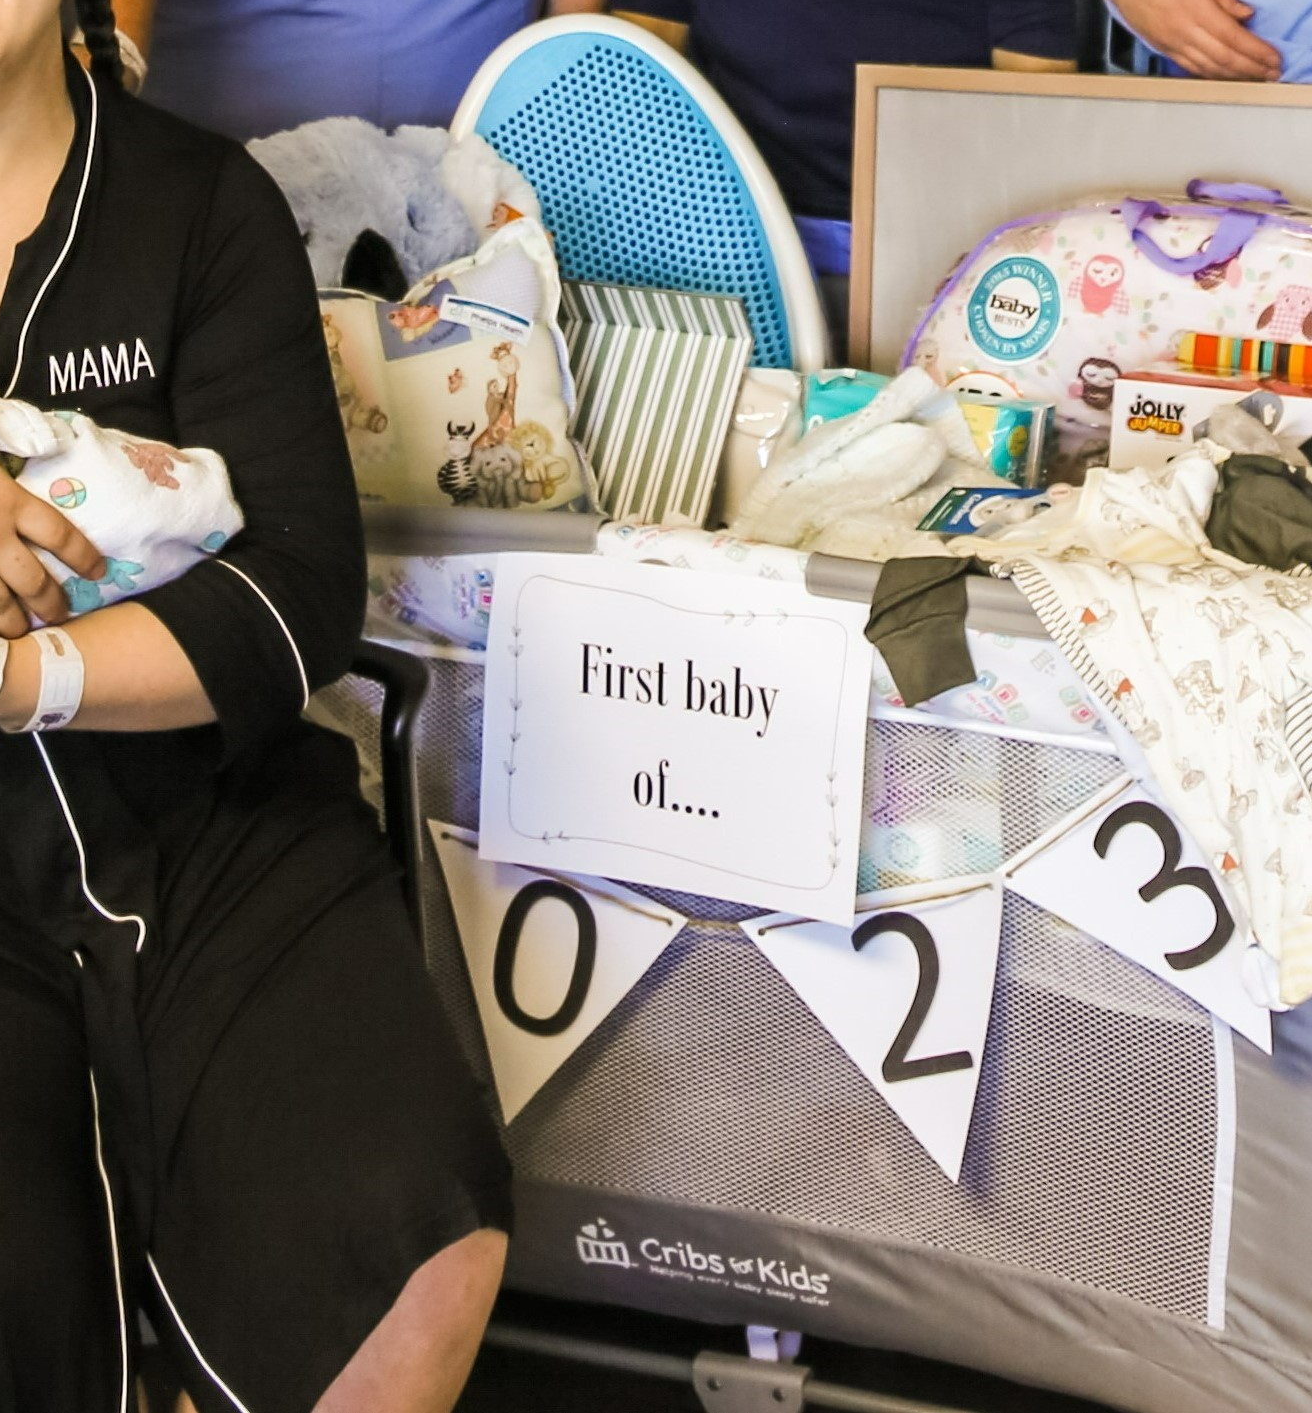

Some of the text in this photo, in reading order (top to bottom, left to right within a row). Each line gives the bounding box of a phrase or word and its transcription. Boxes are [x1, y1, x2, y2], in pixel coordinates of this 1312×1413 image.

[990, 294, 1040, 319] baby
[48, 337, 156, 396] MAMA
[579, 642, 780, 738] First baby
[632, 759, 720, 819] of....
[850, 909, 975, 1084] 2
[1092, 800, 1236, 971] 3
[639, 1238, 830, 1295] Cribs for Kids
[696, 1274, 730, 1287] every
[800, 1295, 830, 1307] safer
